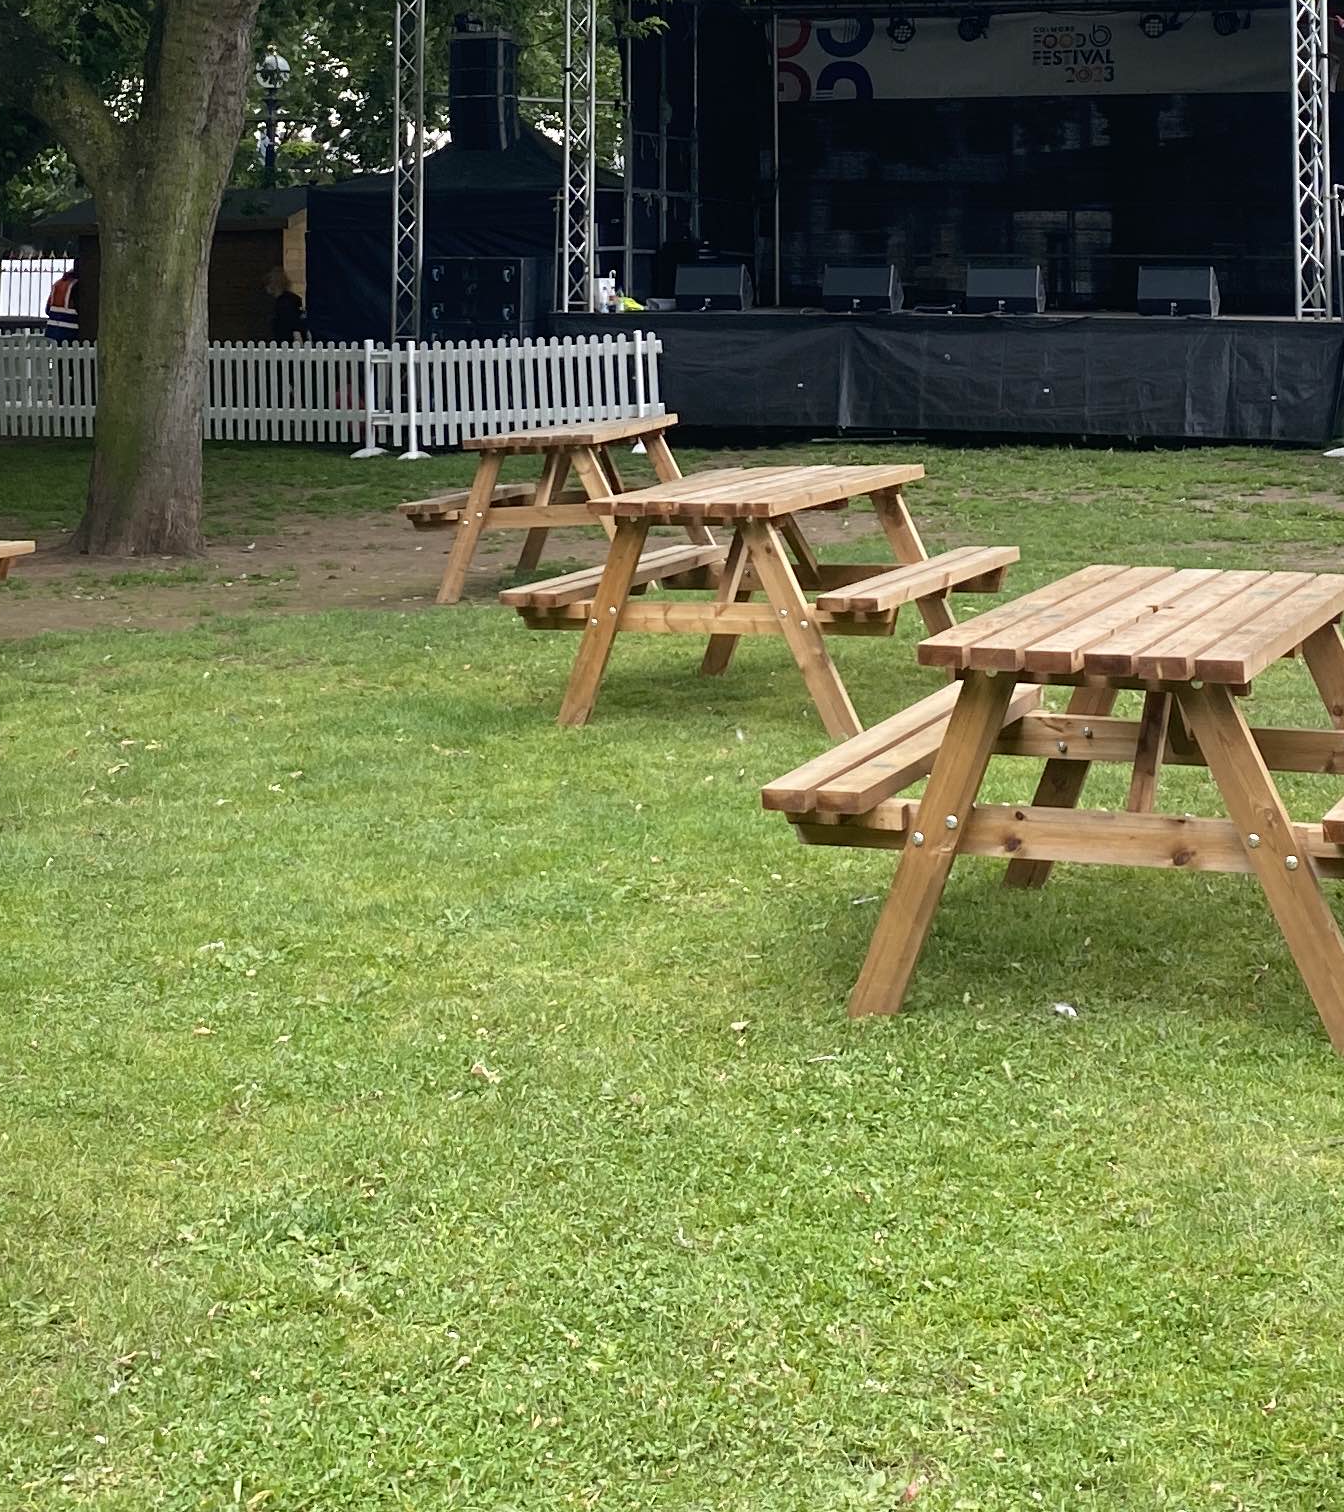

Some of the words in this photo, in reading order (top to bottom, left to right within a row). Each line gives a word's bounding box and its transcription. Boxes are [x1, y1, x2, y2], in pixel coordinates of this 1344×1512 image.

[1032, 33, 1087, 49] FOOD
[1032, 49, 1115, 65] FESTIVAL
[1065, 66, 1115, 82] 2023
